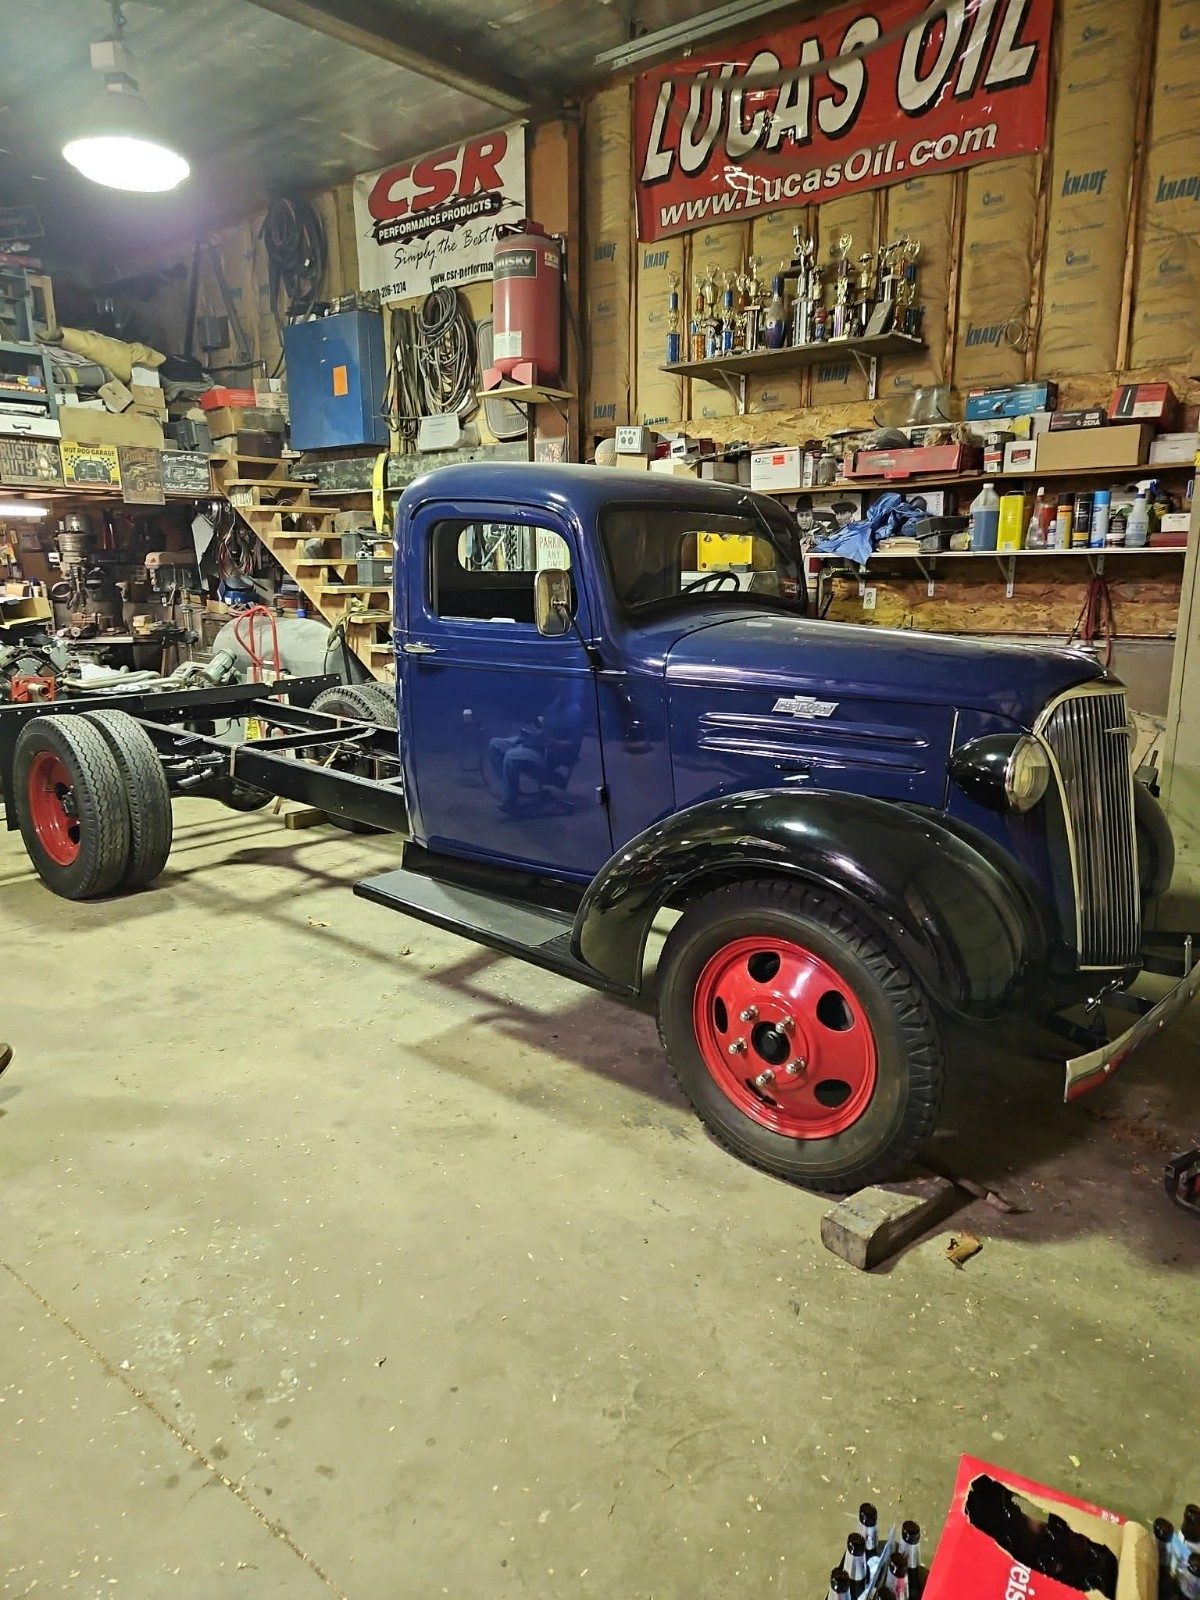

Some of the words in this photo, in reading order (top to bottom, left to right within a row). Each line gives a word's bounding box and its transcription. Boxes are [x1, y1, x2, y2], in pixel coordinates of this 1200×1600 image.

[641, 15, 882, 186] LUCAS
[896, 0, 1040, 116] OIL
[368, 131, 508, 221] CSR
[659, 121, 998, 227] www.LucasOil.com
[1061, 169, 1108, 198] KNAUF
[378, 215, 441, 240] PERFORMANCE
[441, 199, 491, 223] PRODUCTS
[394, 248, 437, 270] Simply
[438, 236, 458, 254] the
[495, 256, 532, 269] HUSKY
[643, 249, 670, 270] KNAUF
[91, 449, 115, 457] GARAGE
